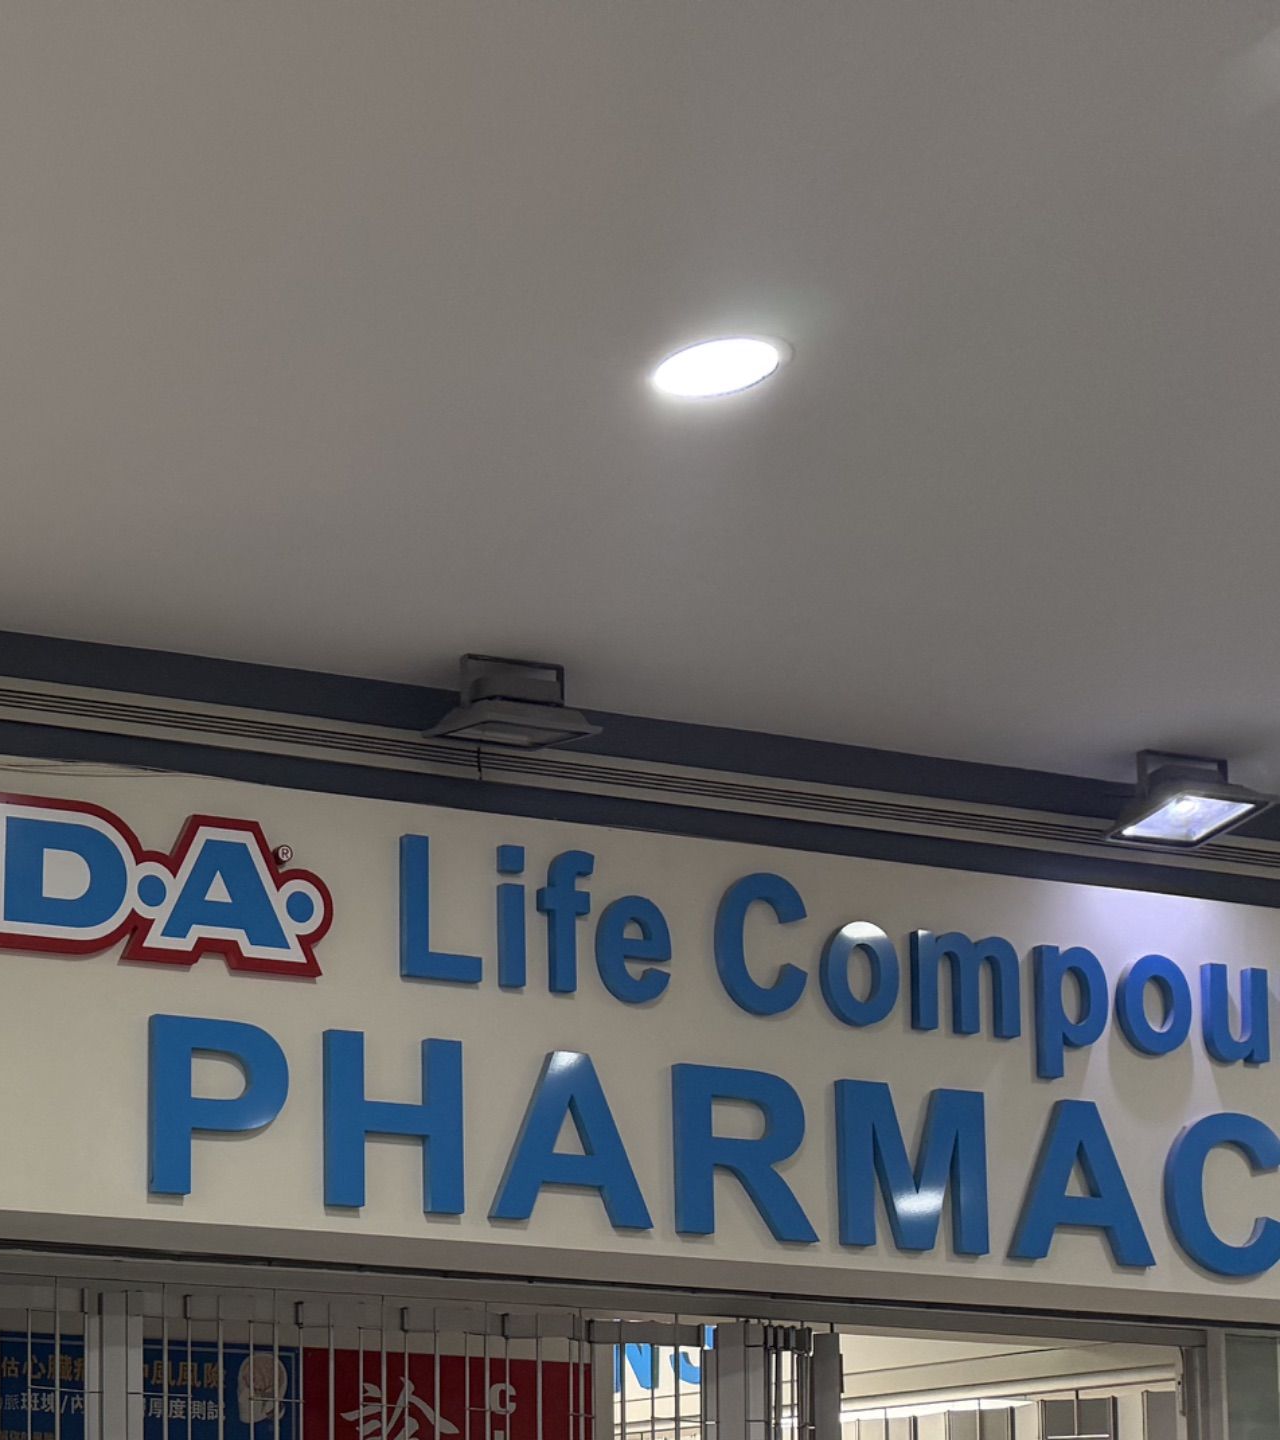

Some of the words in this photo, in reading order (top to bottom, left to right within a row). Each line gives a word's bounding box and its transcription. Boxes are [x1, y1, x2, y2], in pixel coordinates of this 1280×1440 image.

[399, 830, 673, 1003] Life
[712, 870, 1271, 1080] Compou
[148, 1011, 1280, 1277] PHARMAC
